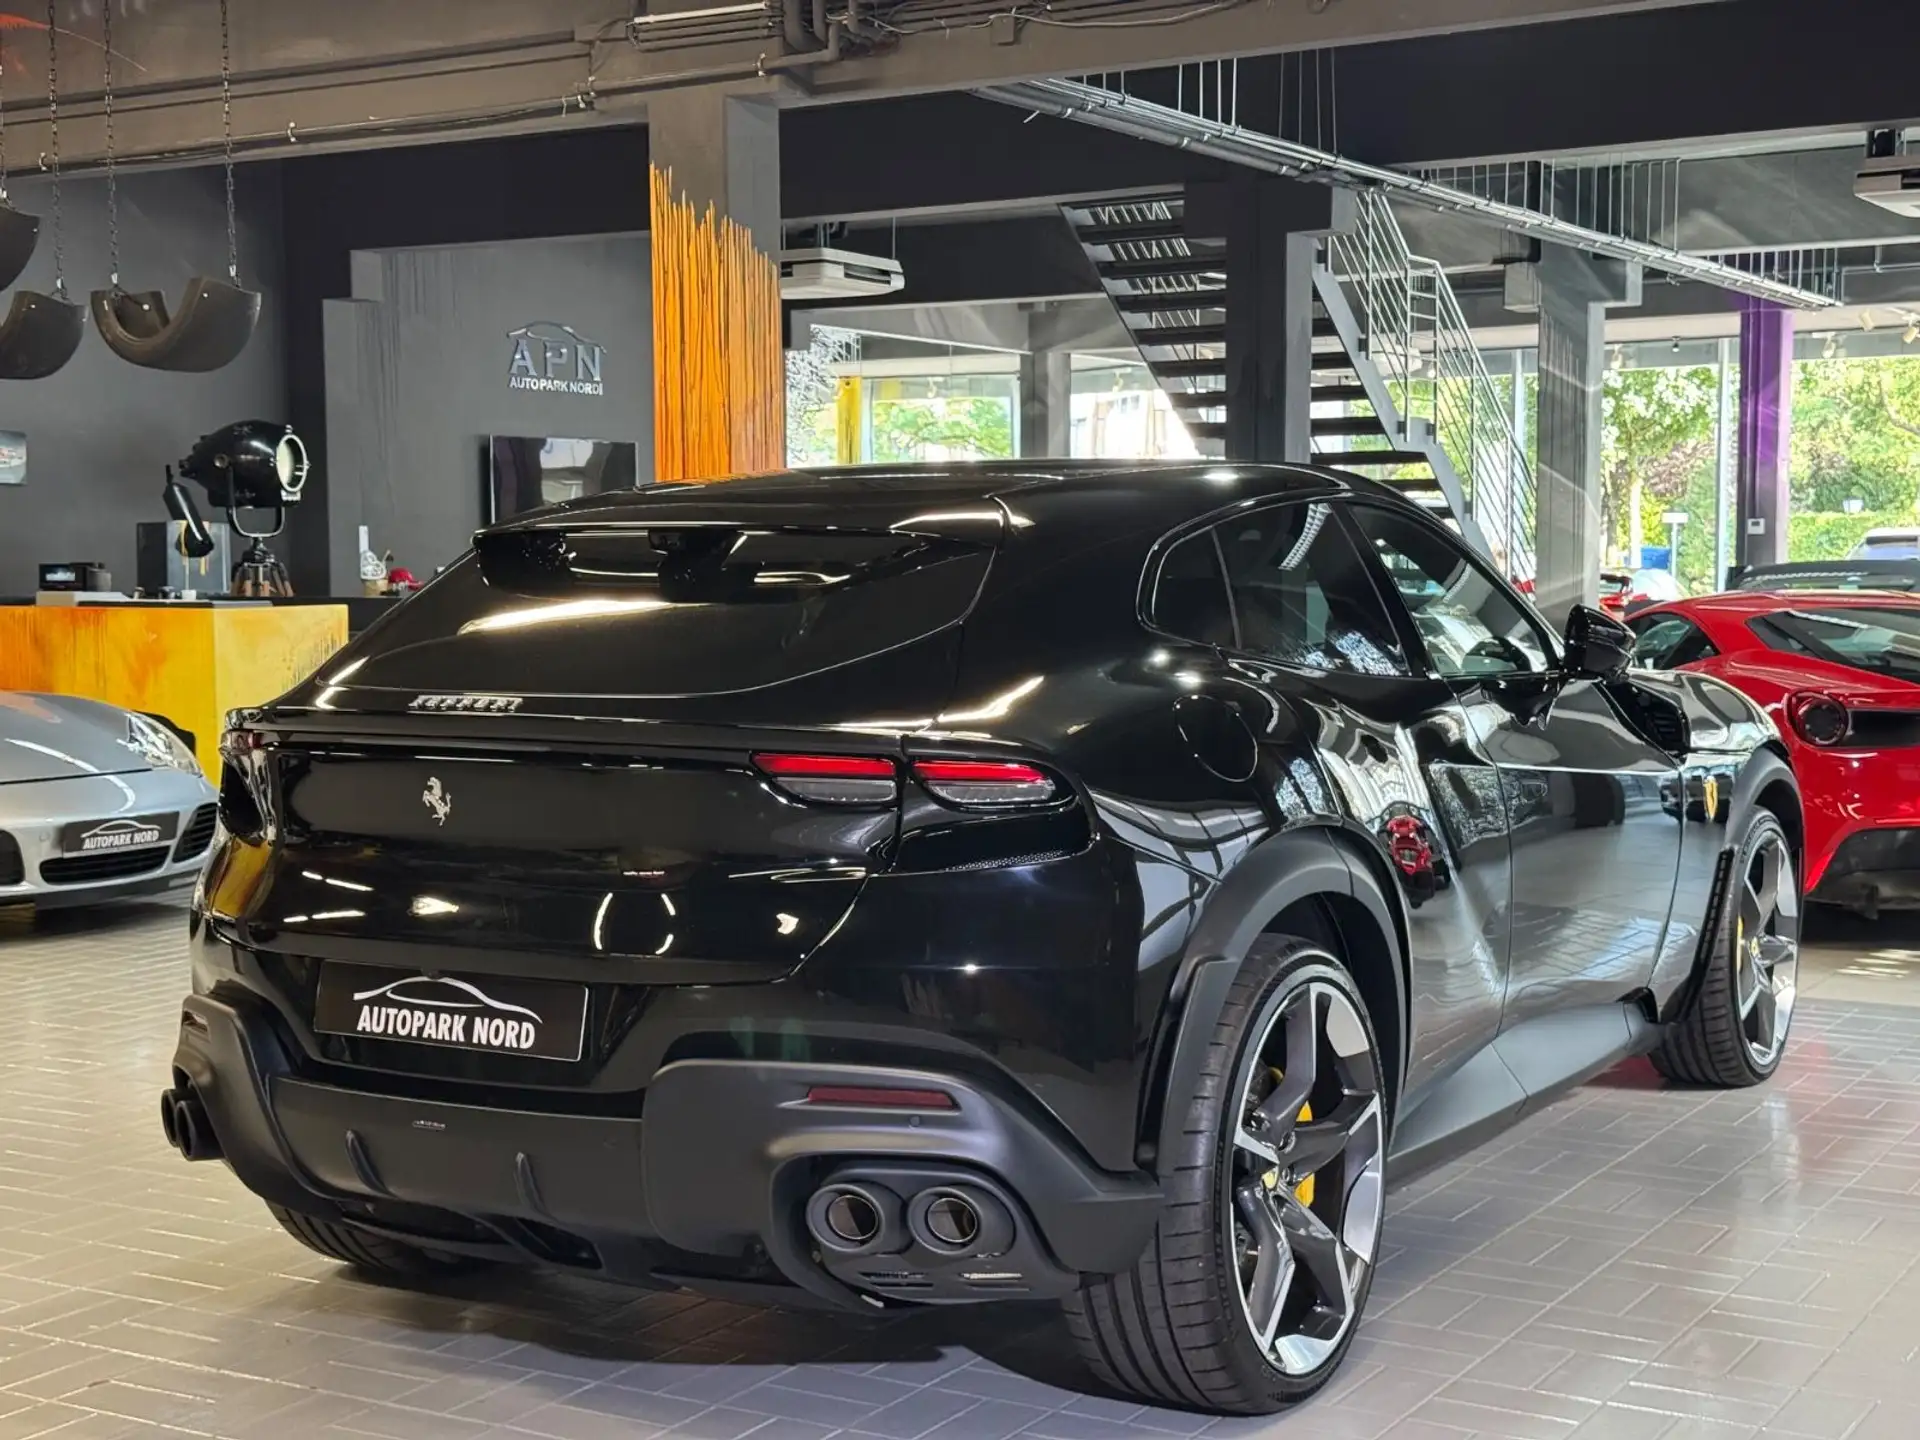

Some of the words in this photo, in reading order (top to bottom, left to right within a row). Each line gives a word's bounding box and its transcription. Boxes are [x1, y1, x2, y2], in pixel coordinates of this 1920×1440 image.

[509, 339, 601, 382] APN
[509, 376, 568, 393] AUTOPARK
[569, 382, 604, 396] NORD
[82, 833, 132, 850] AUTOPARK
[133, 830, 160, 844] NORD
[356, 1004, 468, 1043] AUTOPARK
[472, 1016, 536, 1050] NORD
